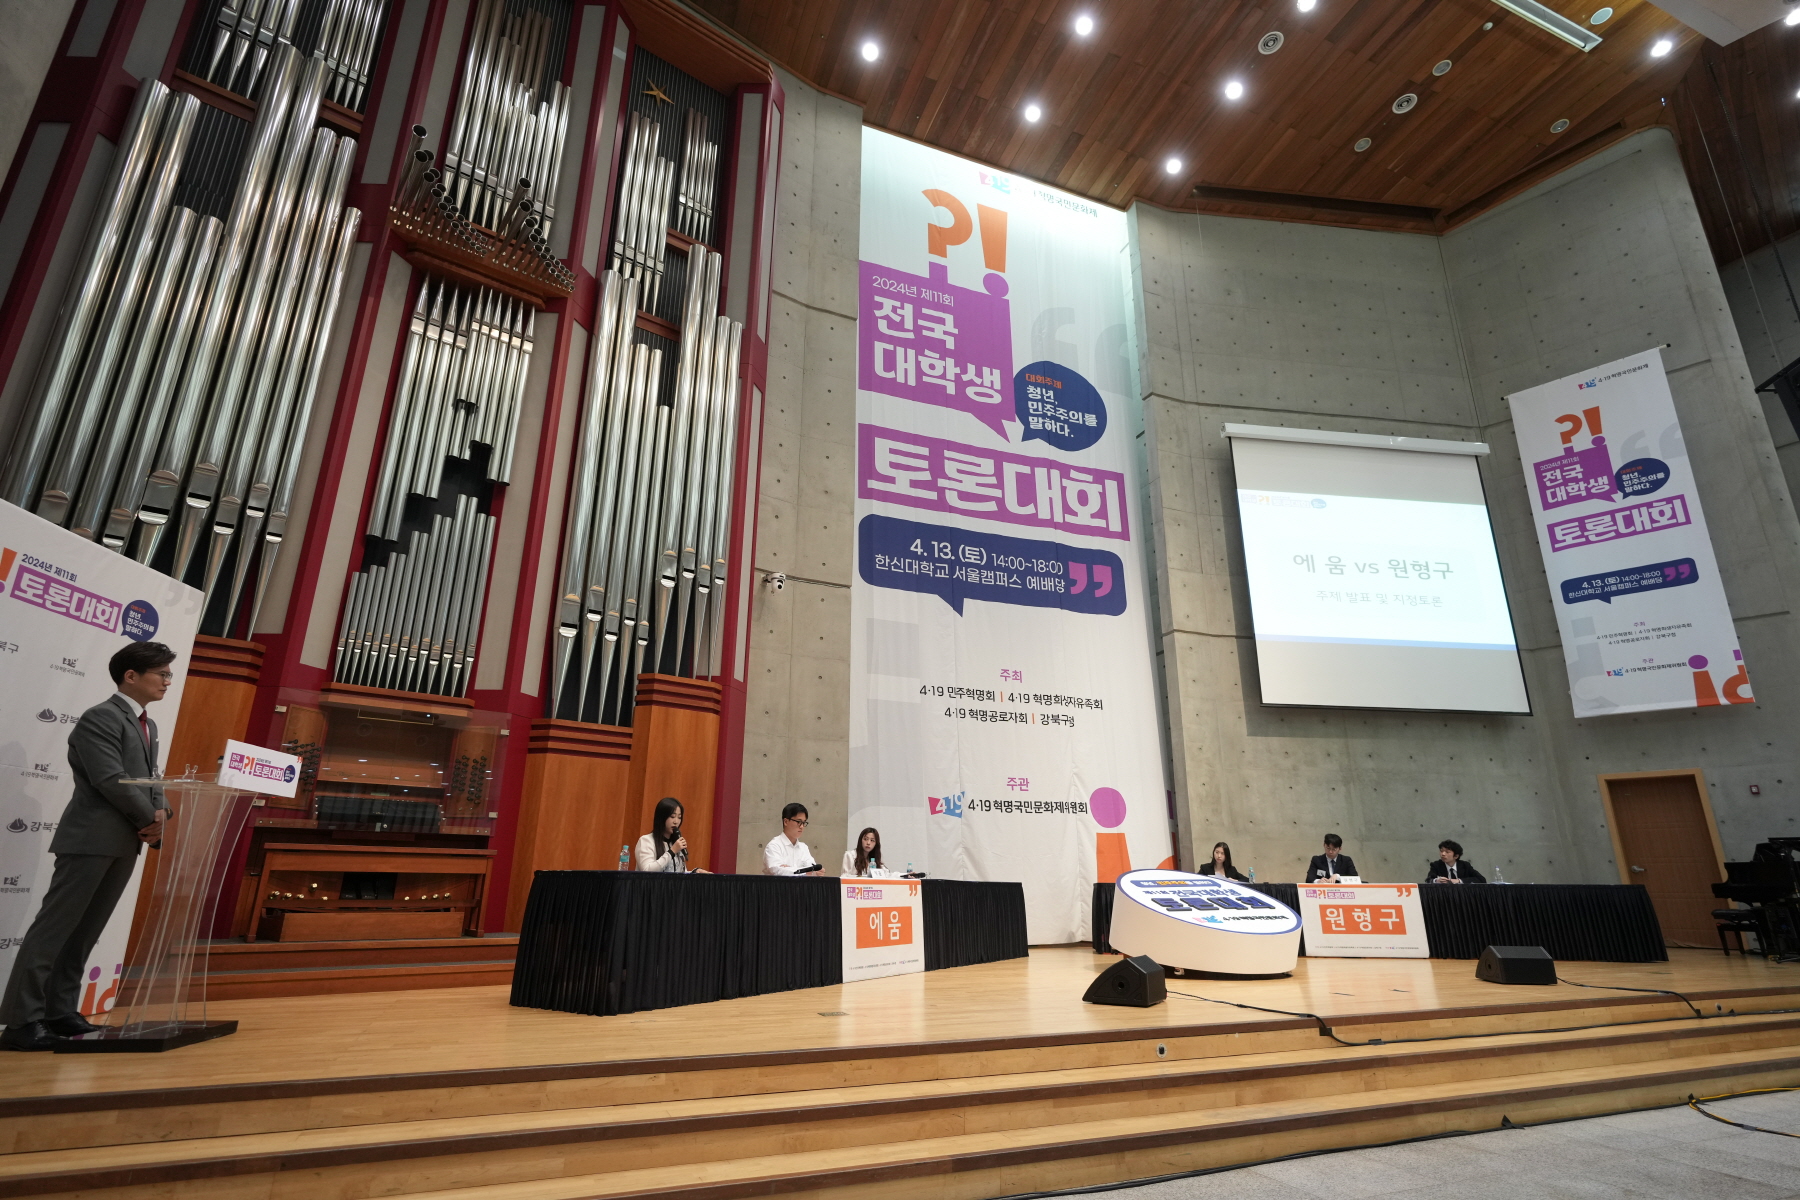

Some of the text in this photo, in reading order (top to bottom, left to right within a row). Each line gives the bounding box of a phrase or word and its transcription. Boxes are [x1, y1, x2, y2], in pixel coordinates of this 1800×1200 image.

[872, 276, 954, 307] 2024년 제11회
[874, 296, 958, 350] 전국
[874, 340, 1002, 404] 대학생
[1026, 374, 1062, 389] 대회주제
[1027, 384, 1058, 405] 청년,
[1028, 401, 1098, 426] 민주주의를
[1028, 416, 1074, 438] 말하다.
[1540, 456, 1579, 470] 2024년 제11회
[868, 436, 1122, 532] 토론대회
[1542, 464, 1583, 486] 전국
[1624, 472, 1665, 486] 민주주의를
[1546, 476, 1610, 503] 대학생
[1554, 499, 1686, 548] 토론대회
[21, 554, 77, 583] 2024년 제11회
[874, 554, 1065, 593] 한신대학교 서울캠퍼스 예배당
[991, 554, 1064, 575] 14:00~18:00
[1388, 559, 1454, 580] 원형구
[1316, 590, 1443, 607] 주제 발표 및 지정토론
[1569, 588, 1602, 598] 한신대학교
[1604, 582, 1639, 592] 서울캠퍼스
[15, 572, 118, 630] 토론대회
[1000, 668, 1022, 683] 주최
[920, 684, 944, 696] 4·19
[948, 686, 995, 702] 민주혁명회
[1008, 692, 1030, 704] 4·19
[944, 707, 966, 718] 4·19
[968, 708, 1028, 724] 혁명공로자회
[253, 764, 284, 780] 토론대회
[1006, 776, 1030, 792] 주관
[968, 799, 1088, 814] 4·19 혁명국민문화제위원회
